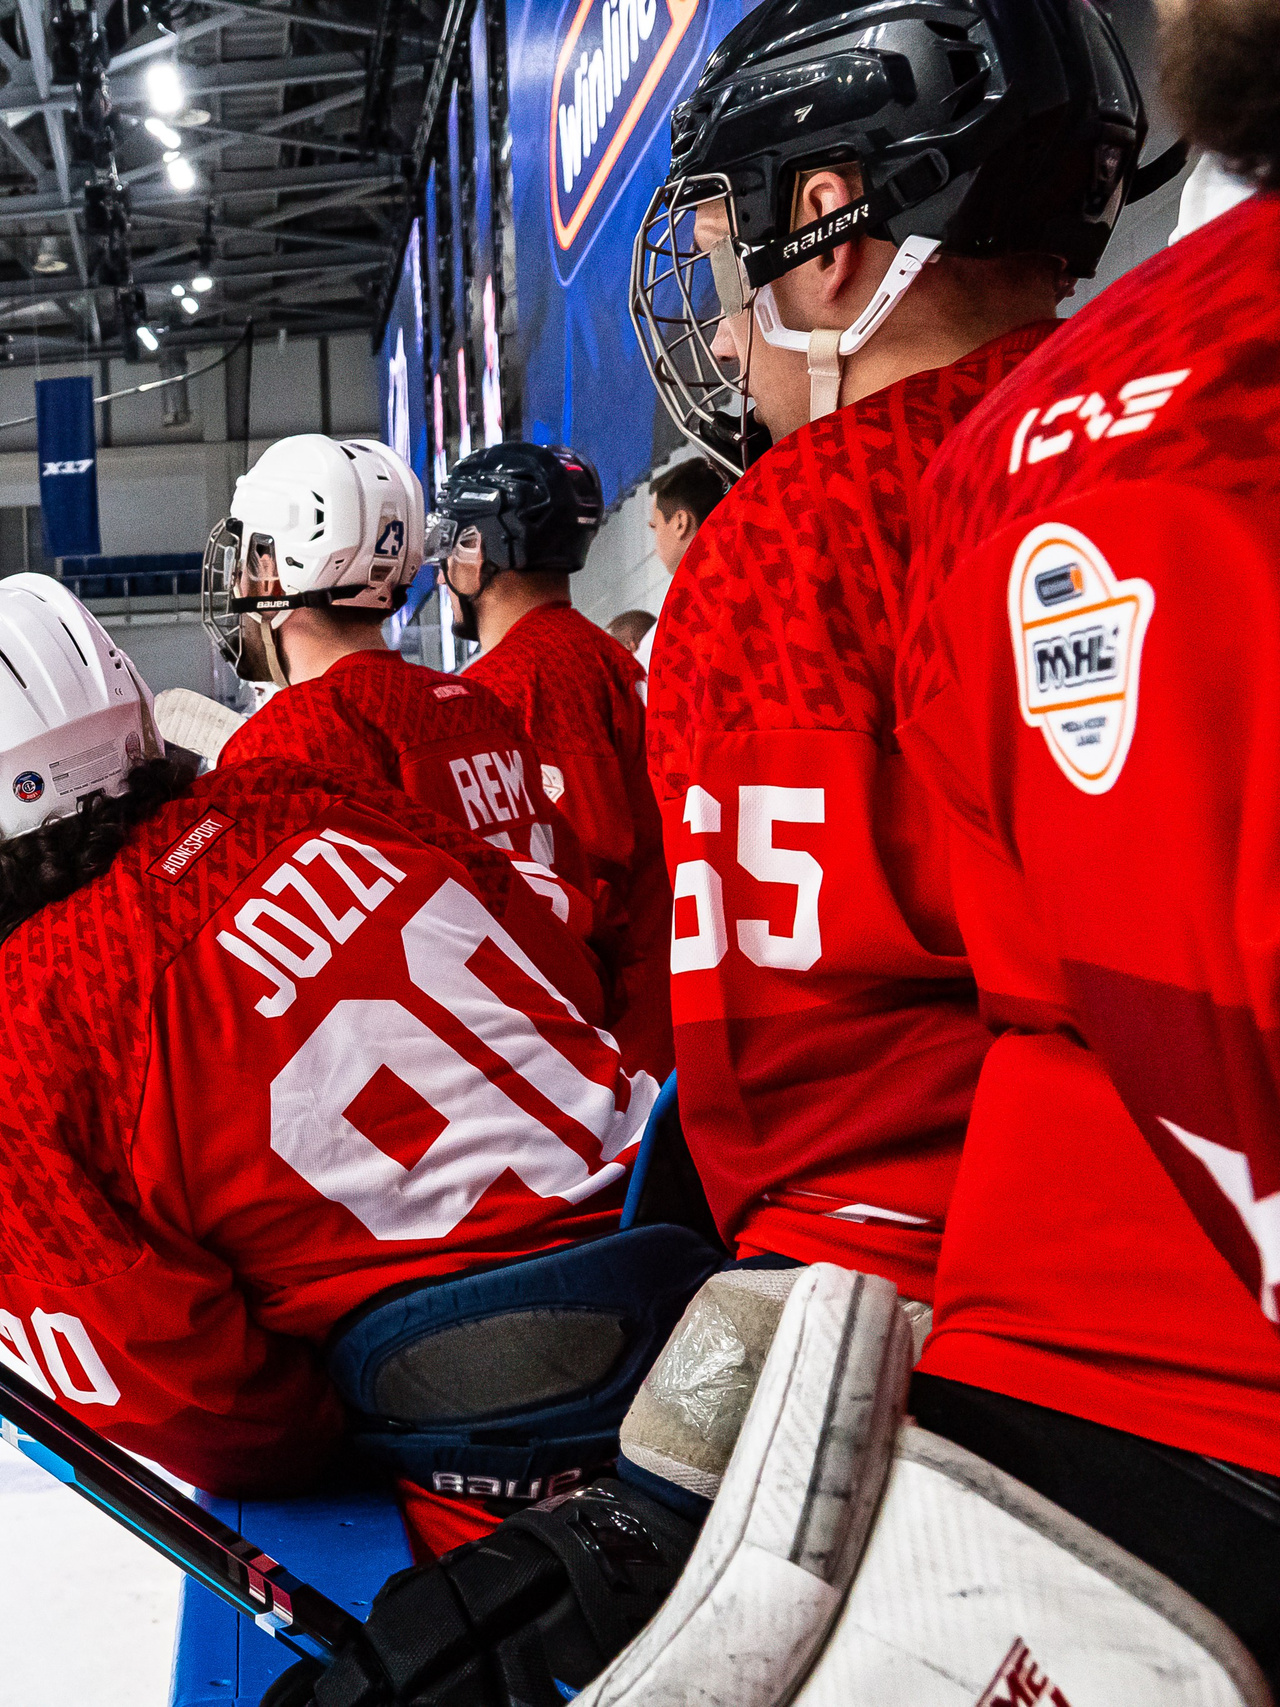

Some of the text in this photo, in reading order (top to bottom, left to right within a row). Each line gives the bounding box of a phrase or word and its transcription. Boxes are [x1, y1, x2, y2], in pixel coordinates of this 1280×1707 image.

[782, 203, 869, 259] BAUER
[375, 519, 404, 556] 23
[256, 600, 290, 609] BAUER
[669, 784, 826, 975] 65
[216, 828, 407, 1019] JOZZI
[270, 877, 663, 1241] 90
[432, 1467, 582, 1500] BAUE
